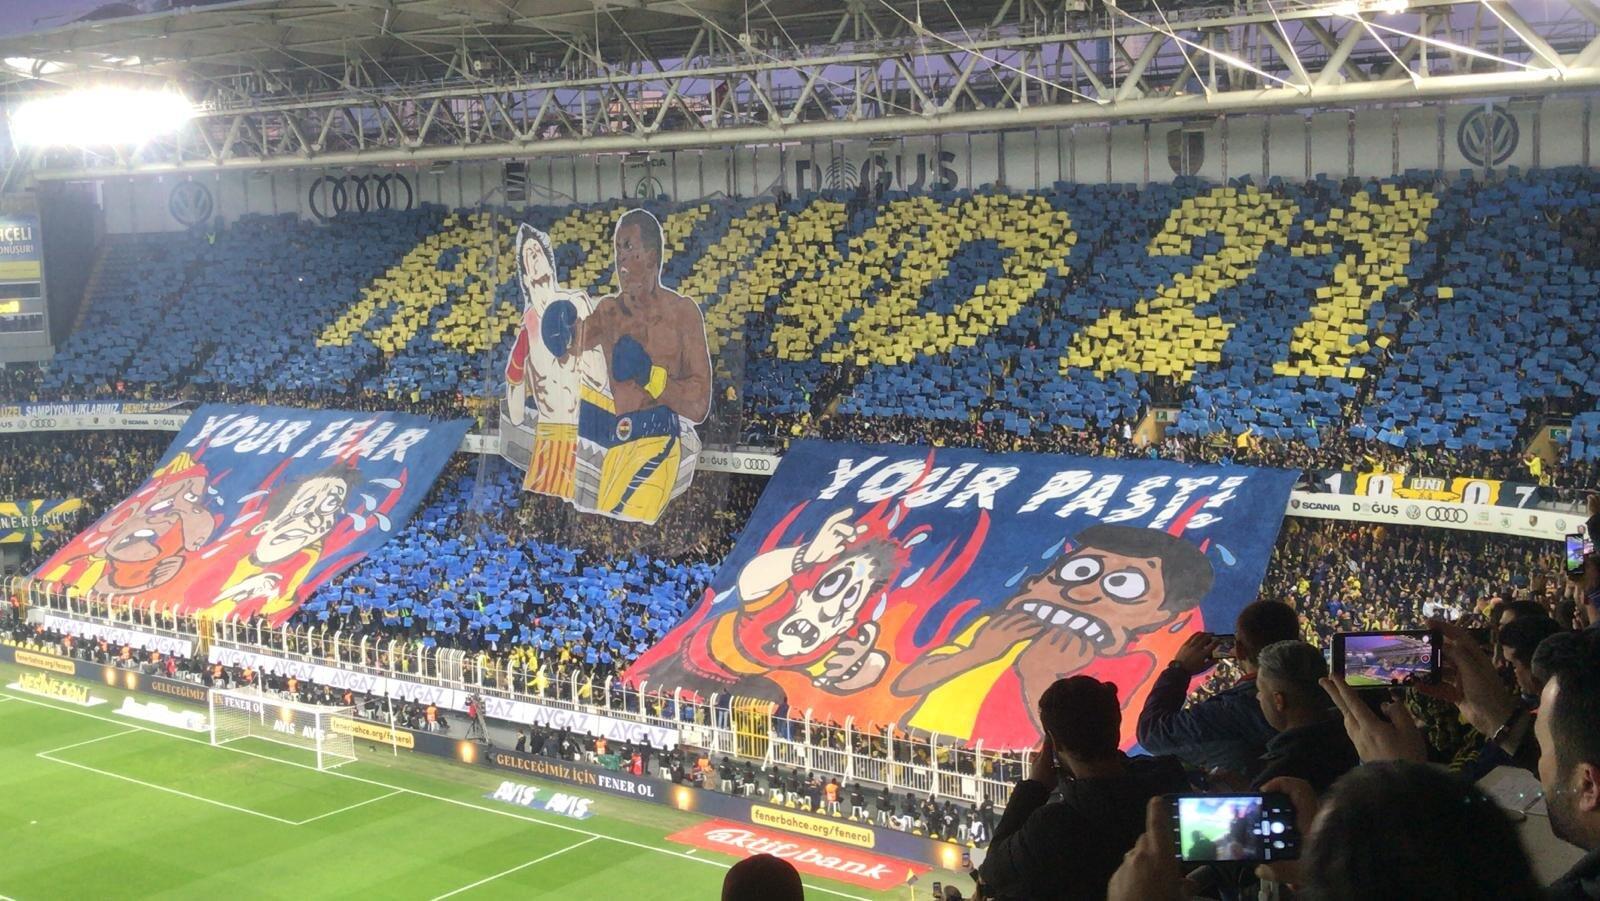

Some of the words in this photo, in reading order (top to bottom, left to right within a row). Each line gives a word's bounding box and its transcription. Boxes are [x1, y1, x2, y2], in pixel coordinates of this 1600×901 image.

[185, 412, 312, 456] YOUR
[292, 416, 430, 463] FEAR
[817, 455, 1020, 509] YOUR
[1016, 468, 1248, 529] PAST!
[1515, 486, 1537, 508] 7
[1302, 502, 1341, 511] SCANIA
[331, 671, 377, 691] AYGAZ
[394, 682, 444, 704] AYGAZ
[535, 707, 589, 731] AYGAZ
[608, 721, 669, 745] AYGAZ
[496, 754, 570, 779] GELECEĞİMİZ
[572, 767, 597, 785] İÇİN
[598, 774, 636, 794] FENER
[637, 783, 655, 797] OL
[493, 781, 540, 806] AVIS
[544, 793, 594, 818] AVIS
[754, 810, 871, 843] fenerbahce.org/fenerol
[794, 848, 892, 879] bank
